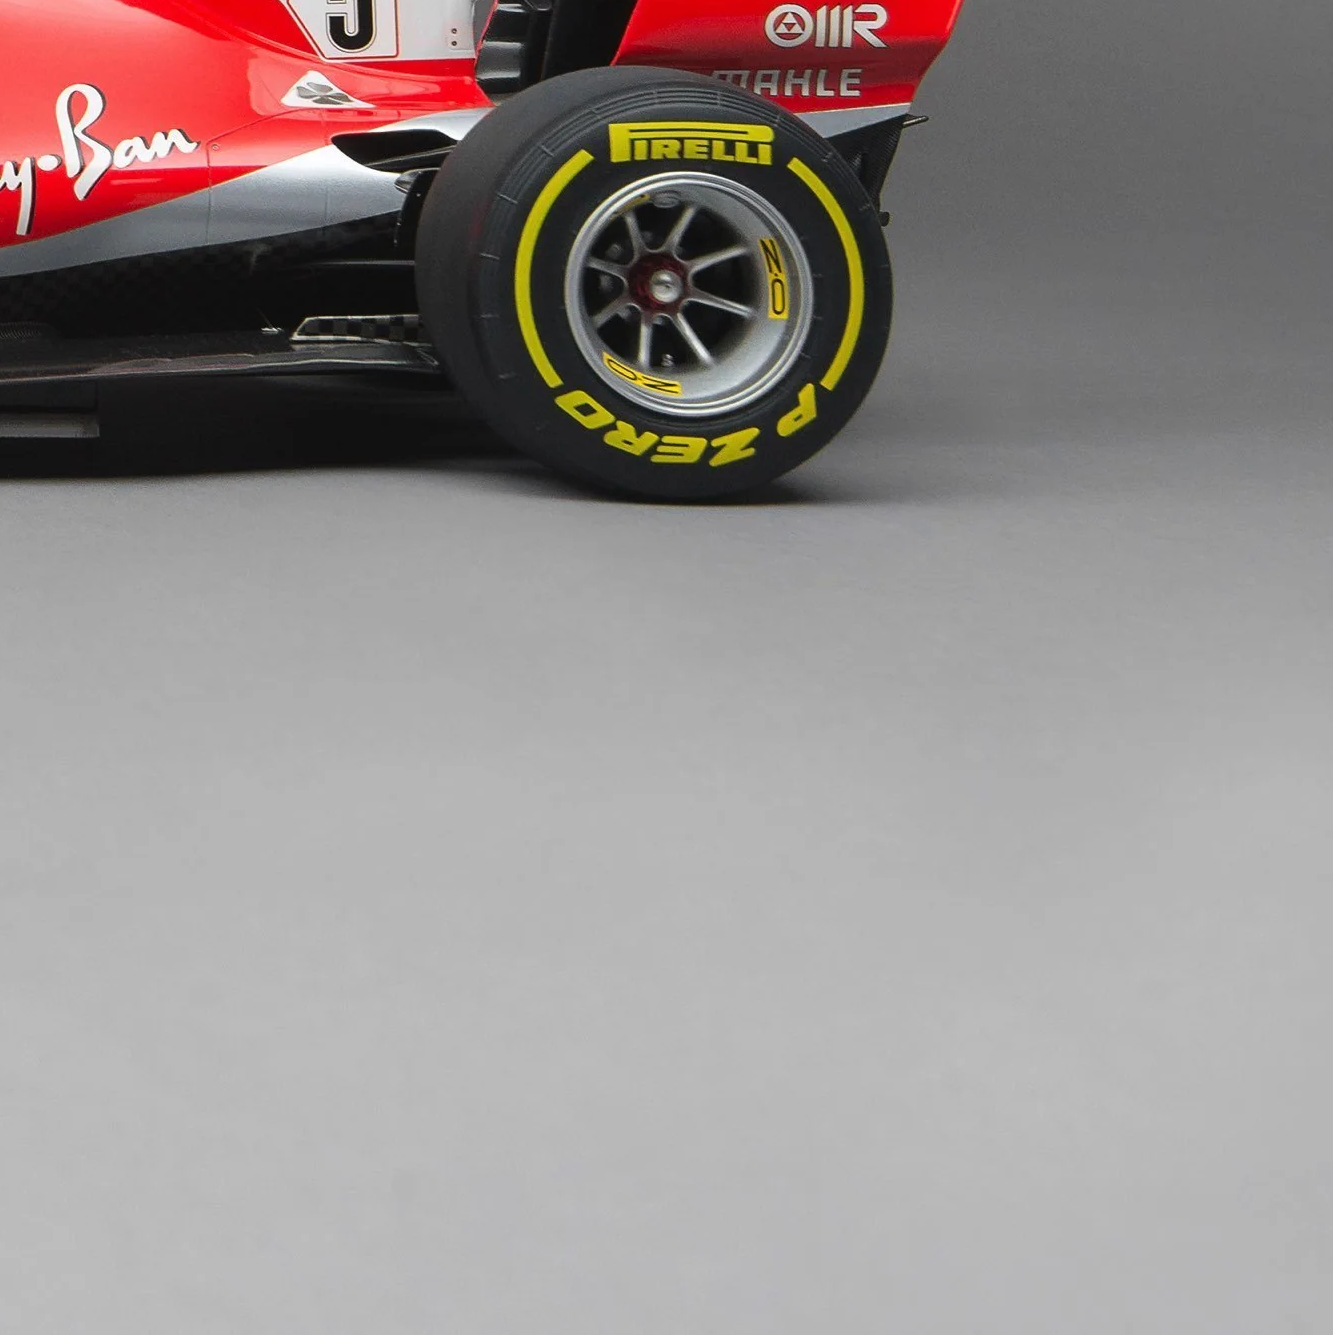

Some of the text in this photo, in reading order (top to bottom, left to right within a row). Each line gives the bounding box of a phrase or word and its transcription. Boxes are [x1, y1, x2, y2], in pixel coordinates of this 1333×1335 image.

[609, 122, 774, 165] PIRELLI
[555, 383, 817, 466] P ZERO
